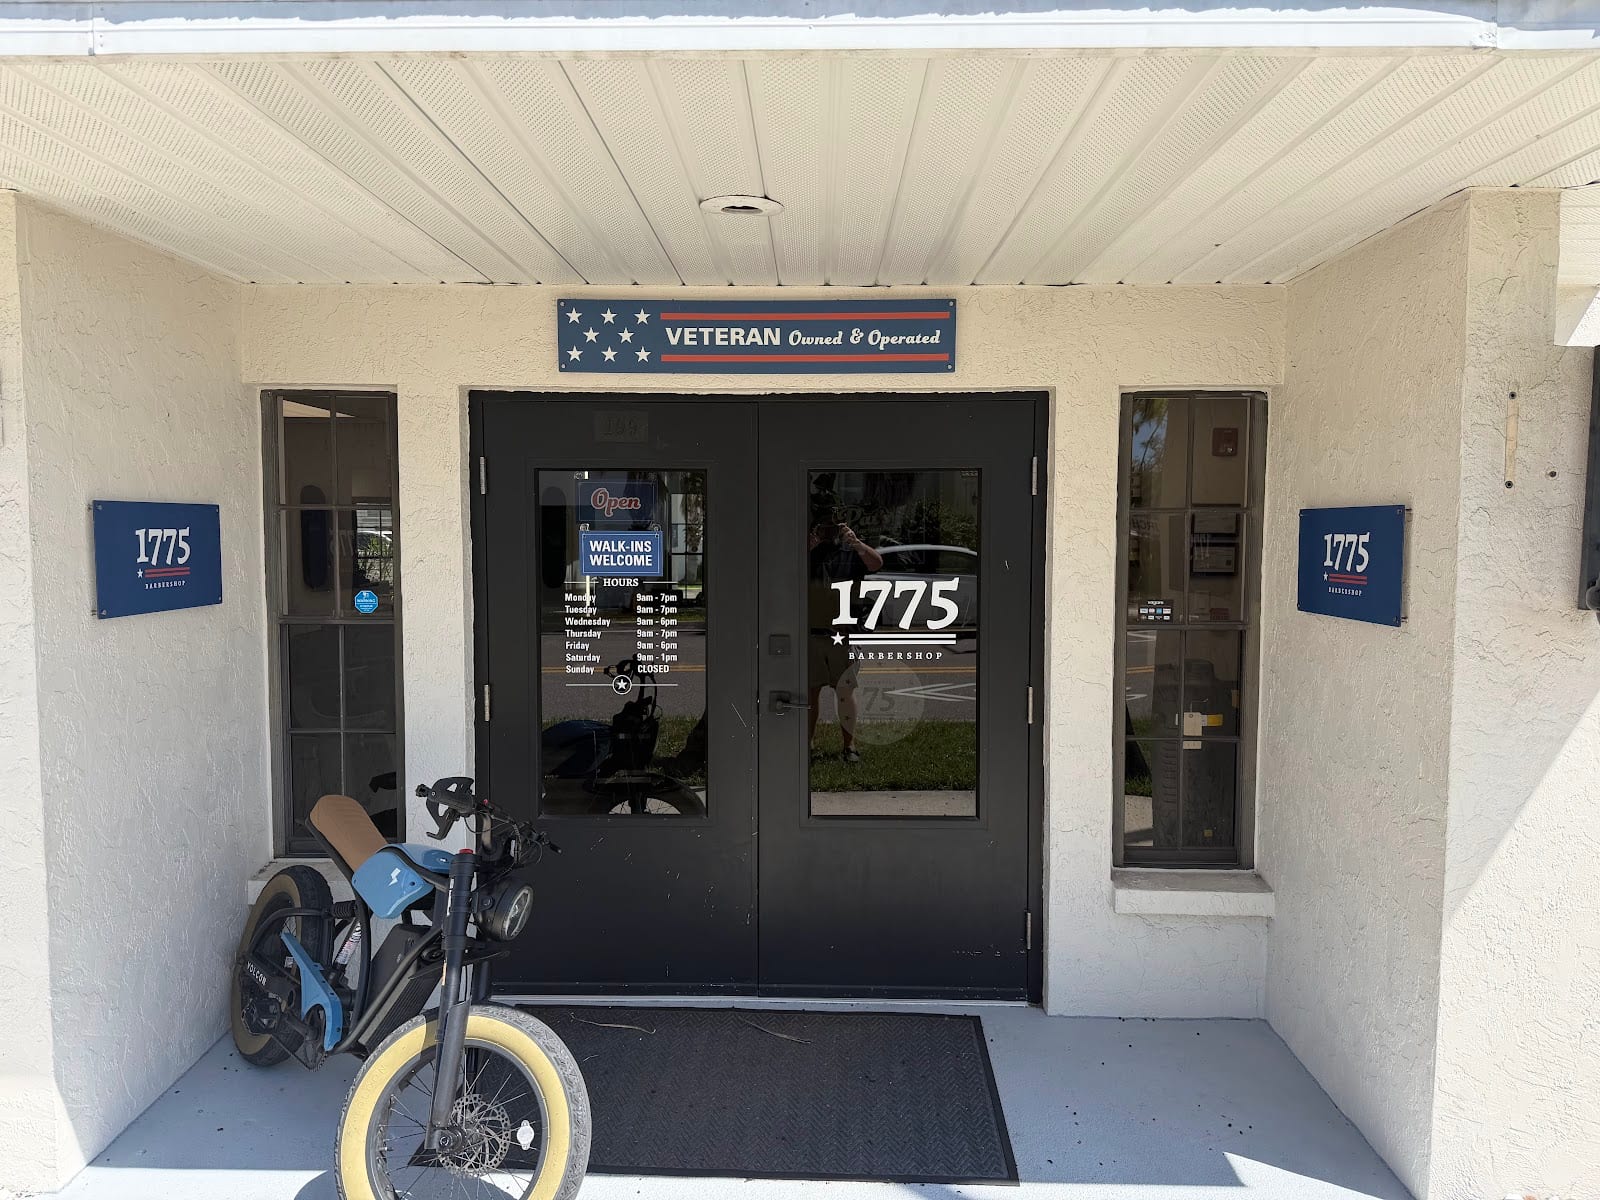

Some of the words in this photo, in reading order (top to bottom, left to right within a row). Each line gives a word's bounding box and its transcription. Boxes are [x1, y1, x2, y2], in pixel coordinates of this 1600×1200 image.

[665, 327, 781, 346] VETERAN
[788, 329, 843, 346] Owned
[849, 327, 865, 345] &
[867, 329, 941, 351] Operated
[591, 487, 641, 517] Open
[135, 526, 191, 567] 1775
[589, 540, 652, 552] WALK-INS
[1323, 531, 1370, 573] 1775
[589, 554, 653, 566] WELCOME
[144, 580, 186, 590] BARBERSHOP
[603, 578, 639, 587] HOURS
[636, 593, 654, 602] 9am
[660, 593, 678, 604] 7pm
[830, 576, 960, 631] 1775
[565, 605, 597, 615] Tuesday
[636, 605, 654, 614] 9am
[660, 605, 678, 616] 7pm
[565, 617, 611, 627] Wednesday
[636, 617, 654, 626] 9am
[660, 617, 678, 628] 6pm
[565, 629, 601, 639] Thursday
[636, 629, 654, 638] 9am
[660, 629, 678, 640] 7pm
[565, 641, 590, 651] Friday
[636, 641, 654, 650] 9am
[660, 641, 678, 652] 6pm
[565, 653, 601, 663] Saturday
[636, 653, 654, 662] 9am
[660, 653, 678, 664] 1pm
[848, 651, 943, 660] BARBERSHOP
[565, 665, 595, 675] Sunday
[637, 665, 670, 673] CLOSED
